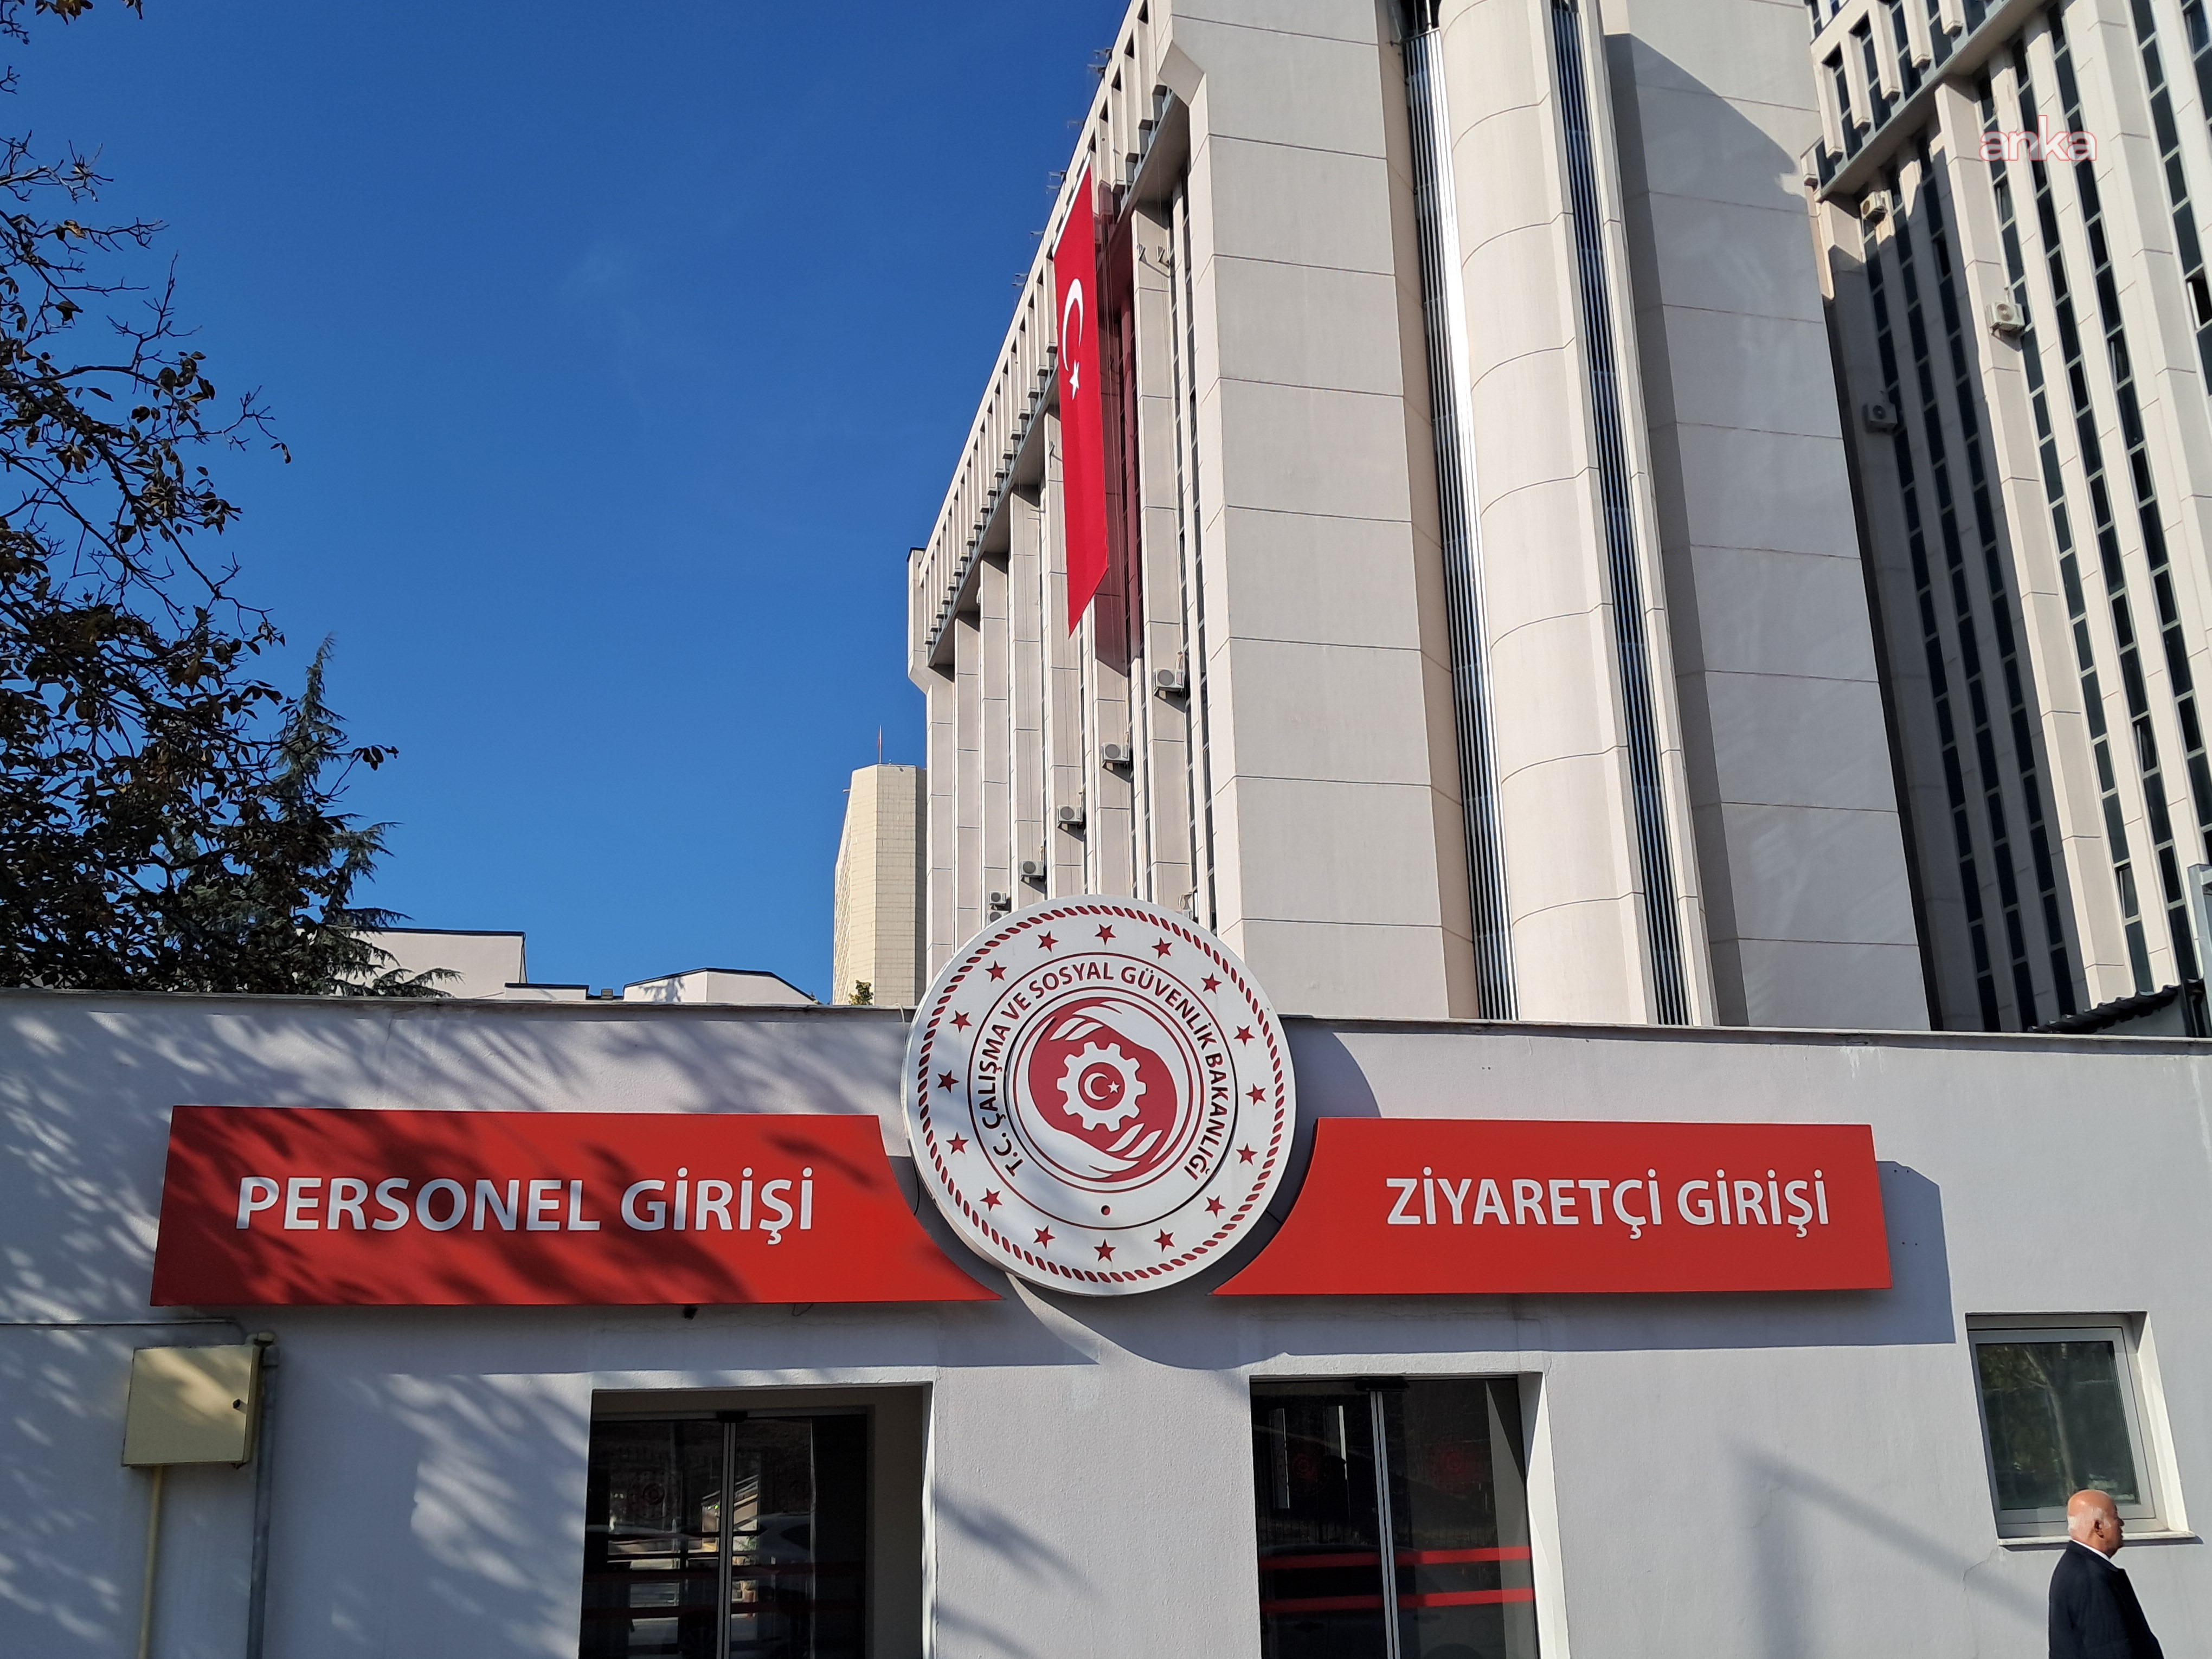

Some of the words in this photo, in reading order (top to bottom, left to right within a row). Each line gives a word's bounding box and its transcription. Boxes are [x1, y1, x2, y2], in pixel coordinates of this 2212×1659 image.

[1000, 992, 1032, 1020] VE
[1029, 962, 1114, 1000] SOSYAL
[1121, 966, 1218, 1051] GÜVENLİK
[978, 1024, 1011, 1129] ÇALIŞMA
[993, 1132, 1024, 1177] T.C.
[1184, 1052, 1229, 1181] BAKANLIĞI
[236, 1176, 601, 1231] PERSONEL
[620, 1166, 814, 1245] GİRİŞİ
[1386, 1166, 1663, 1240] ZİYARETÇİ
[1676, 1168, 1829, 1238] GİRİŞİ
